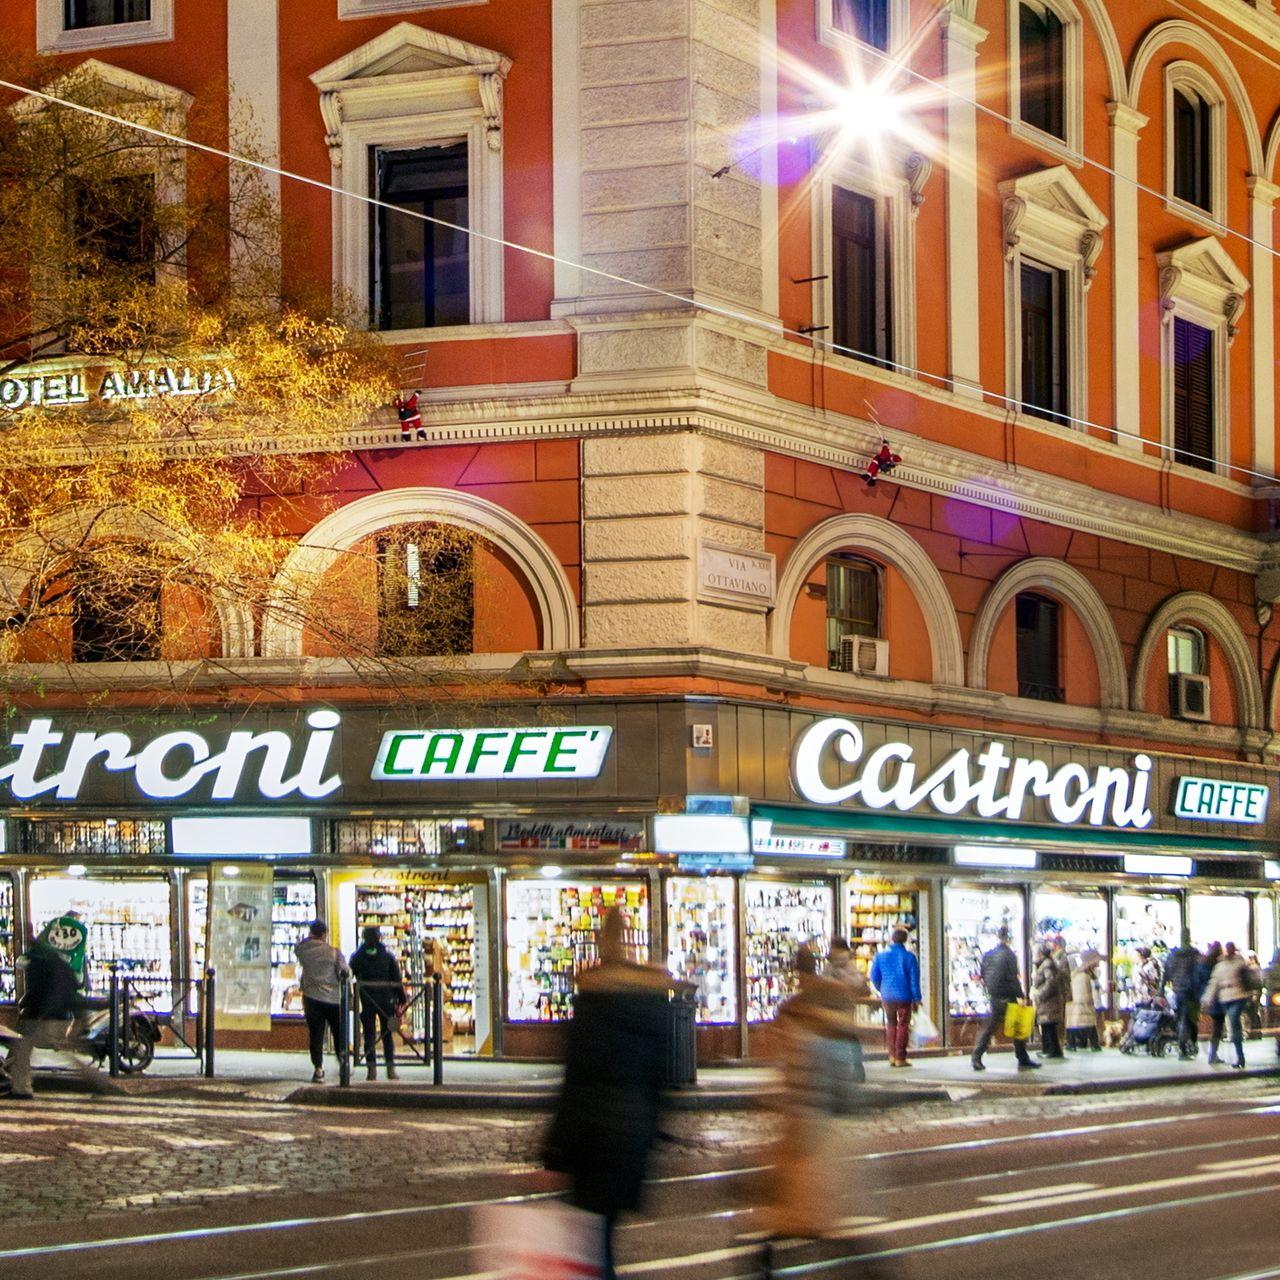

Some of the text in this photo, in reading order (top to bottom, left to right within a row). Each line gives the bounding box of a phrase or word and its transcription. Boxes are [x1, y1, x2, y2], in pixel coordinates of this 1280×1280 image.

[729, 559, 746, 571] VIA
[708, 574, 767, 593] OTTAVIANO
[795, 718, 1152, 828] Castroni
